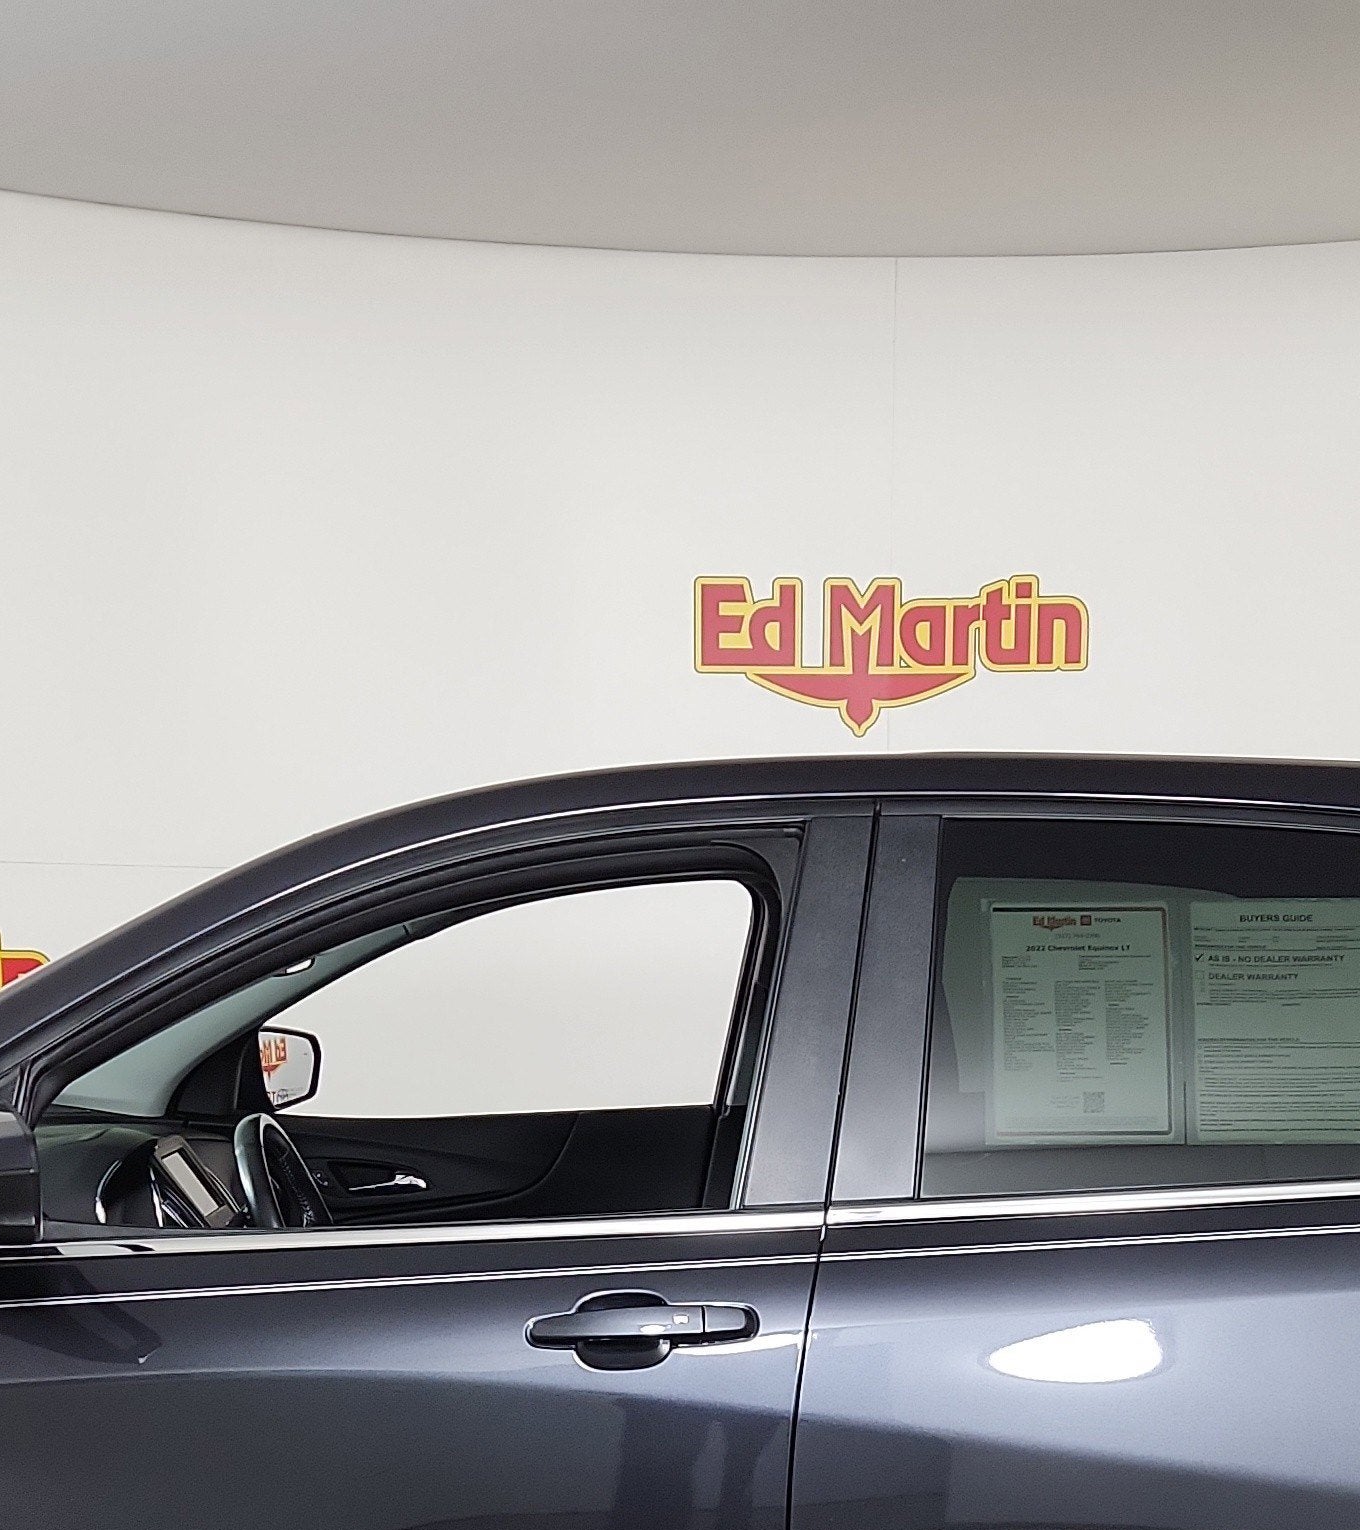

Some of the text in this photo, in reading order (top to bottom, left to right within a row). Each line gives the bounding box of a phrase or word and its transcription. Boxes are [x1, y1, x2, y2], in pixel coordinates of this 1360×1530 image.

[694, 575, 1090, 673] Ed Martin
[1239, 914, 1314, 923] BUYERS GUIDE
[1047, 944, 1086, 952] Chevrolet
[1087, 944, 1119, 952] Equinox
[1207, 955, 1220, 963] AS
[1222, 955, 1231, 963] IS
[1238, 955, 1252, 963] NO
[1253, 955, 1291, 963] DEALER
[1292, 954, 1346, 963] WARRANTY
[1208, 973, 1299, 981] DEALER WARRANTY
